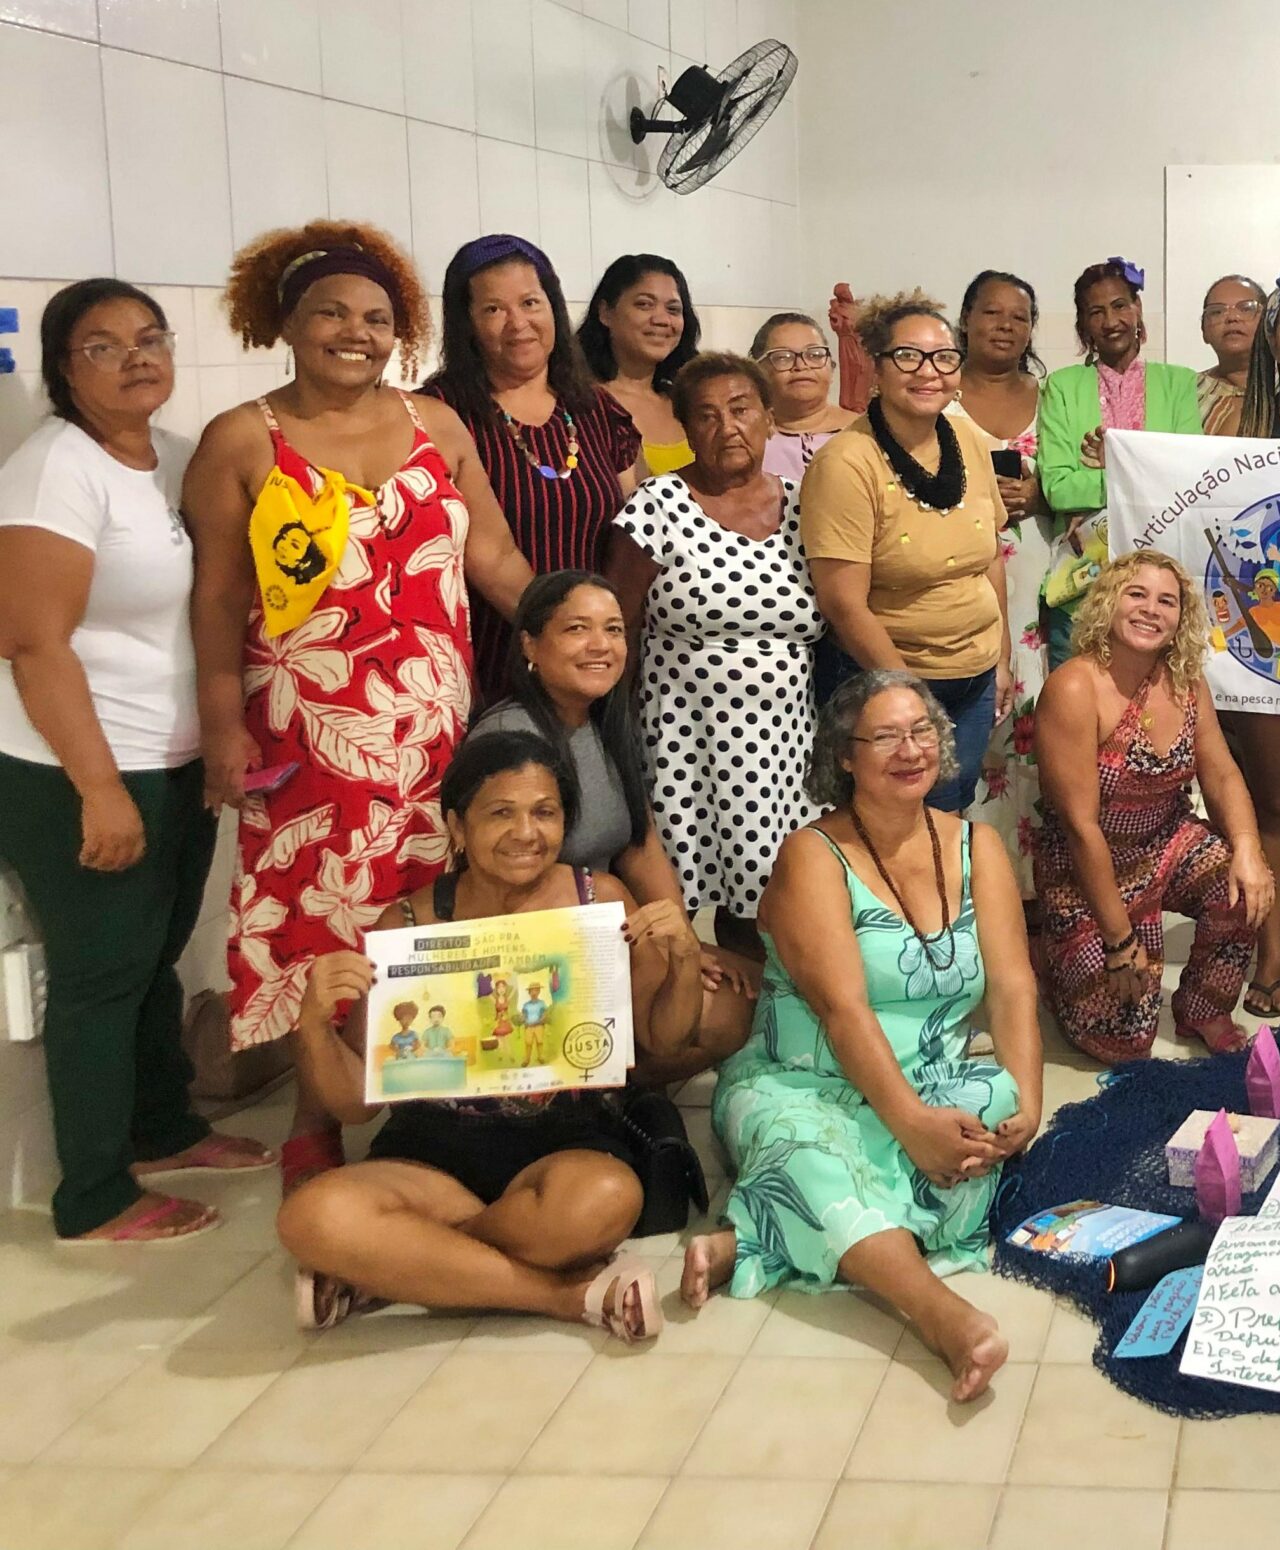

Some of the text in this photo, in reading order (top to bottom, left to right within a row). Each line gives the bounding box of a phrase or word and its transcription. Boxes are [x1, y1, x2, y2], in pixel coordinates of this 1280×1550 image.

[1132, 467, 1231, 551] Articulação
[1215, 692, 1223, 701] e
[1224, 694, 1238, 703] na
[1241, 694, 1274, 706] pesca
[417, 936, 469, 950] DIREITOS
[390, 955, 500, 976] RESPONSABILIDADES
[566, 1038, 610, 1054] JUSTA
